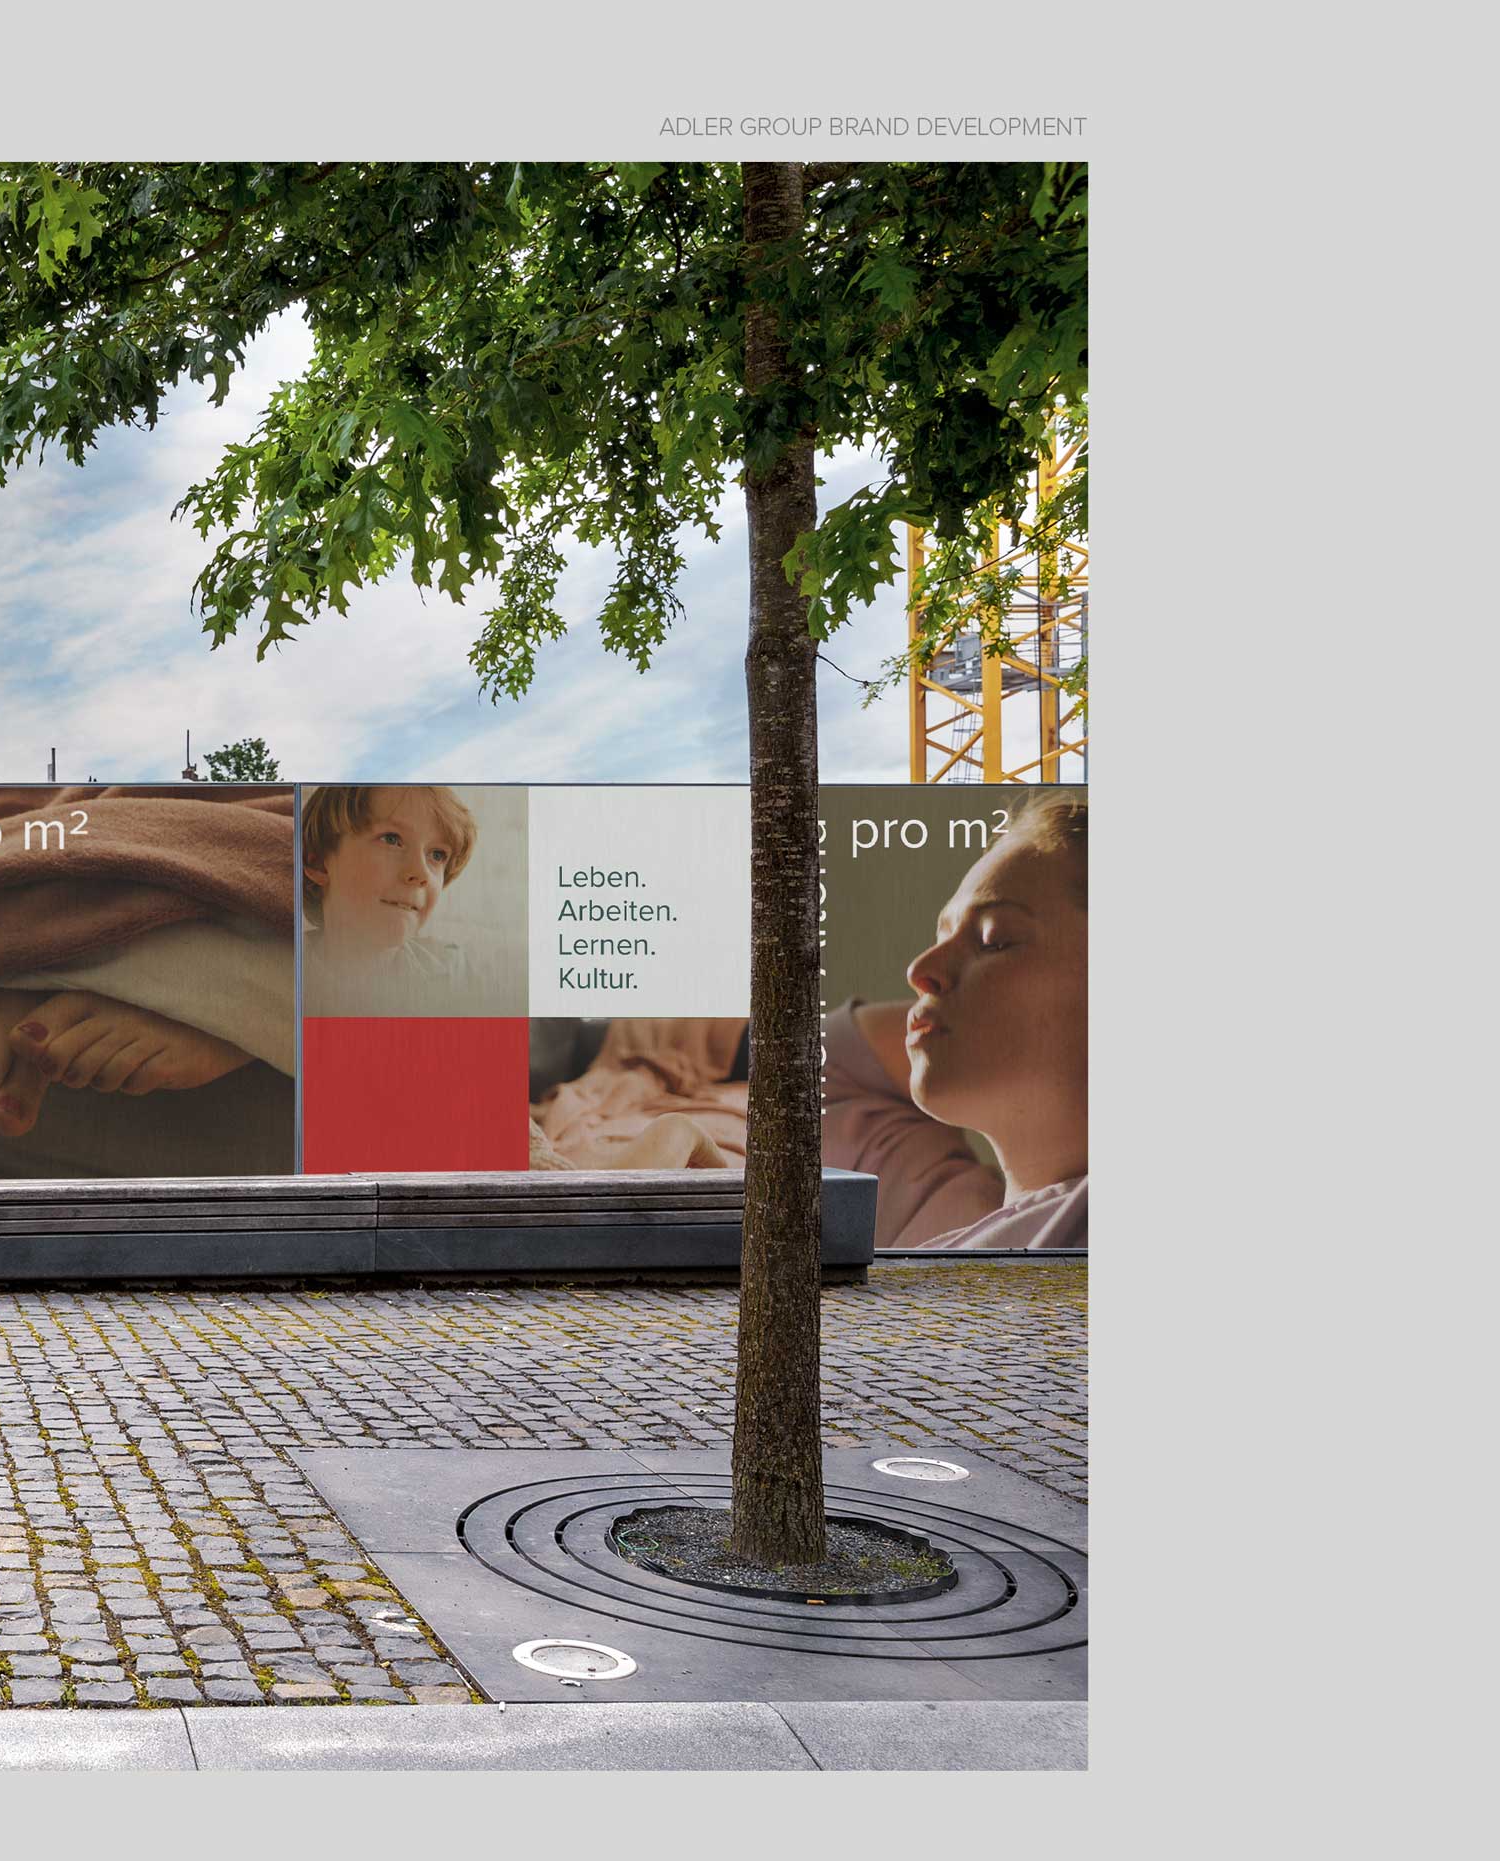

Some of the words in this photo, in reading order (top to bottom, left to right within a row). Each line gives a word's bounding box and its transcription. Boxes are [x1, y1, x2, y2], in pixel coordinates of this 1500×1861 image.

[853, 820, 927, 857] pro
[559, 866, 645, 887] Leben.
[558, 900, 676, 921] Arbeiten.
[560, 934, 655, 955] Lernen.
[560, 968, 637, 989] Kultur.
